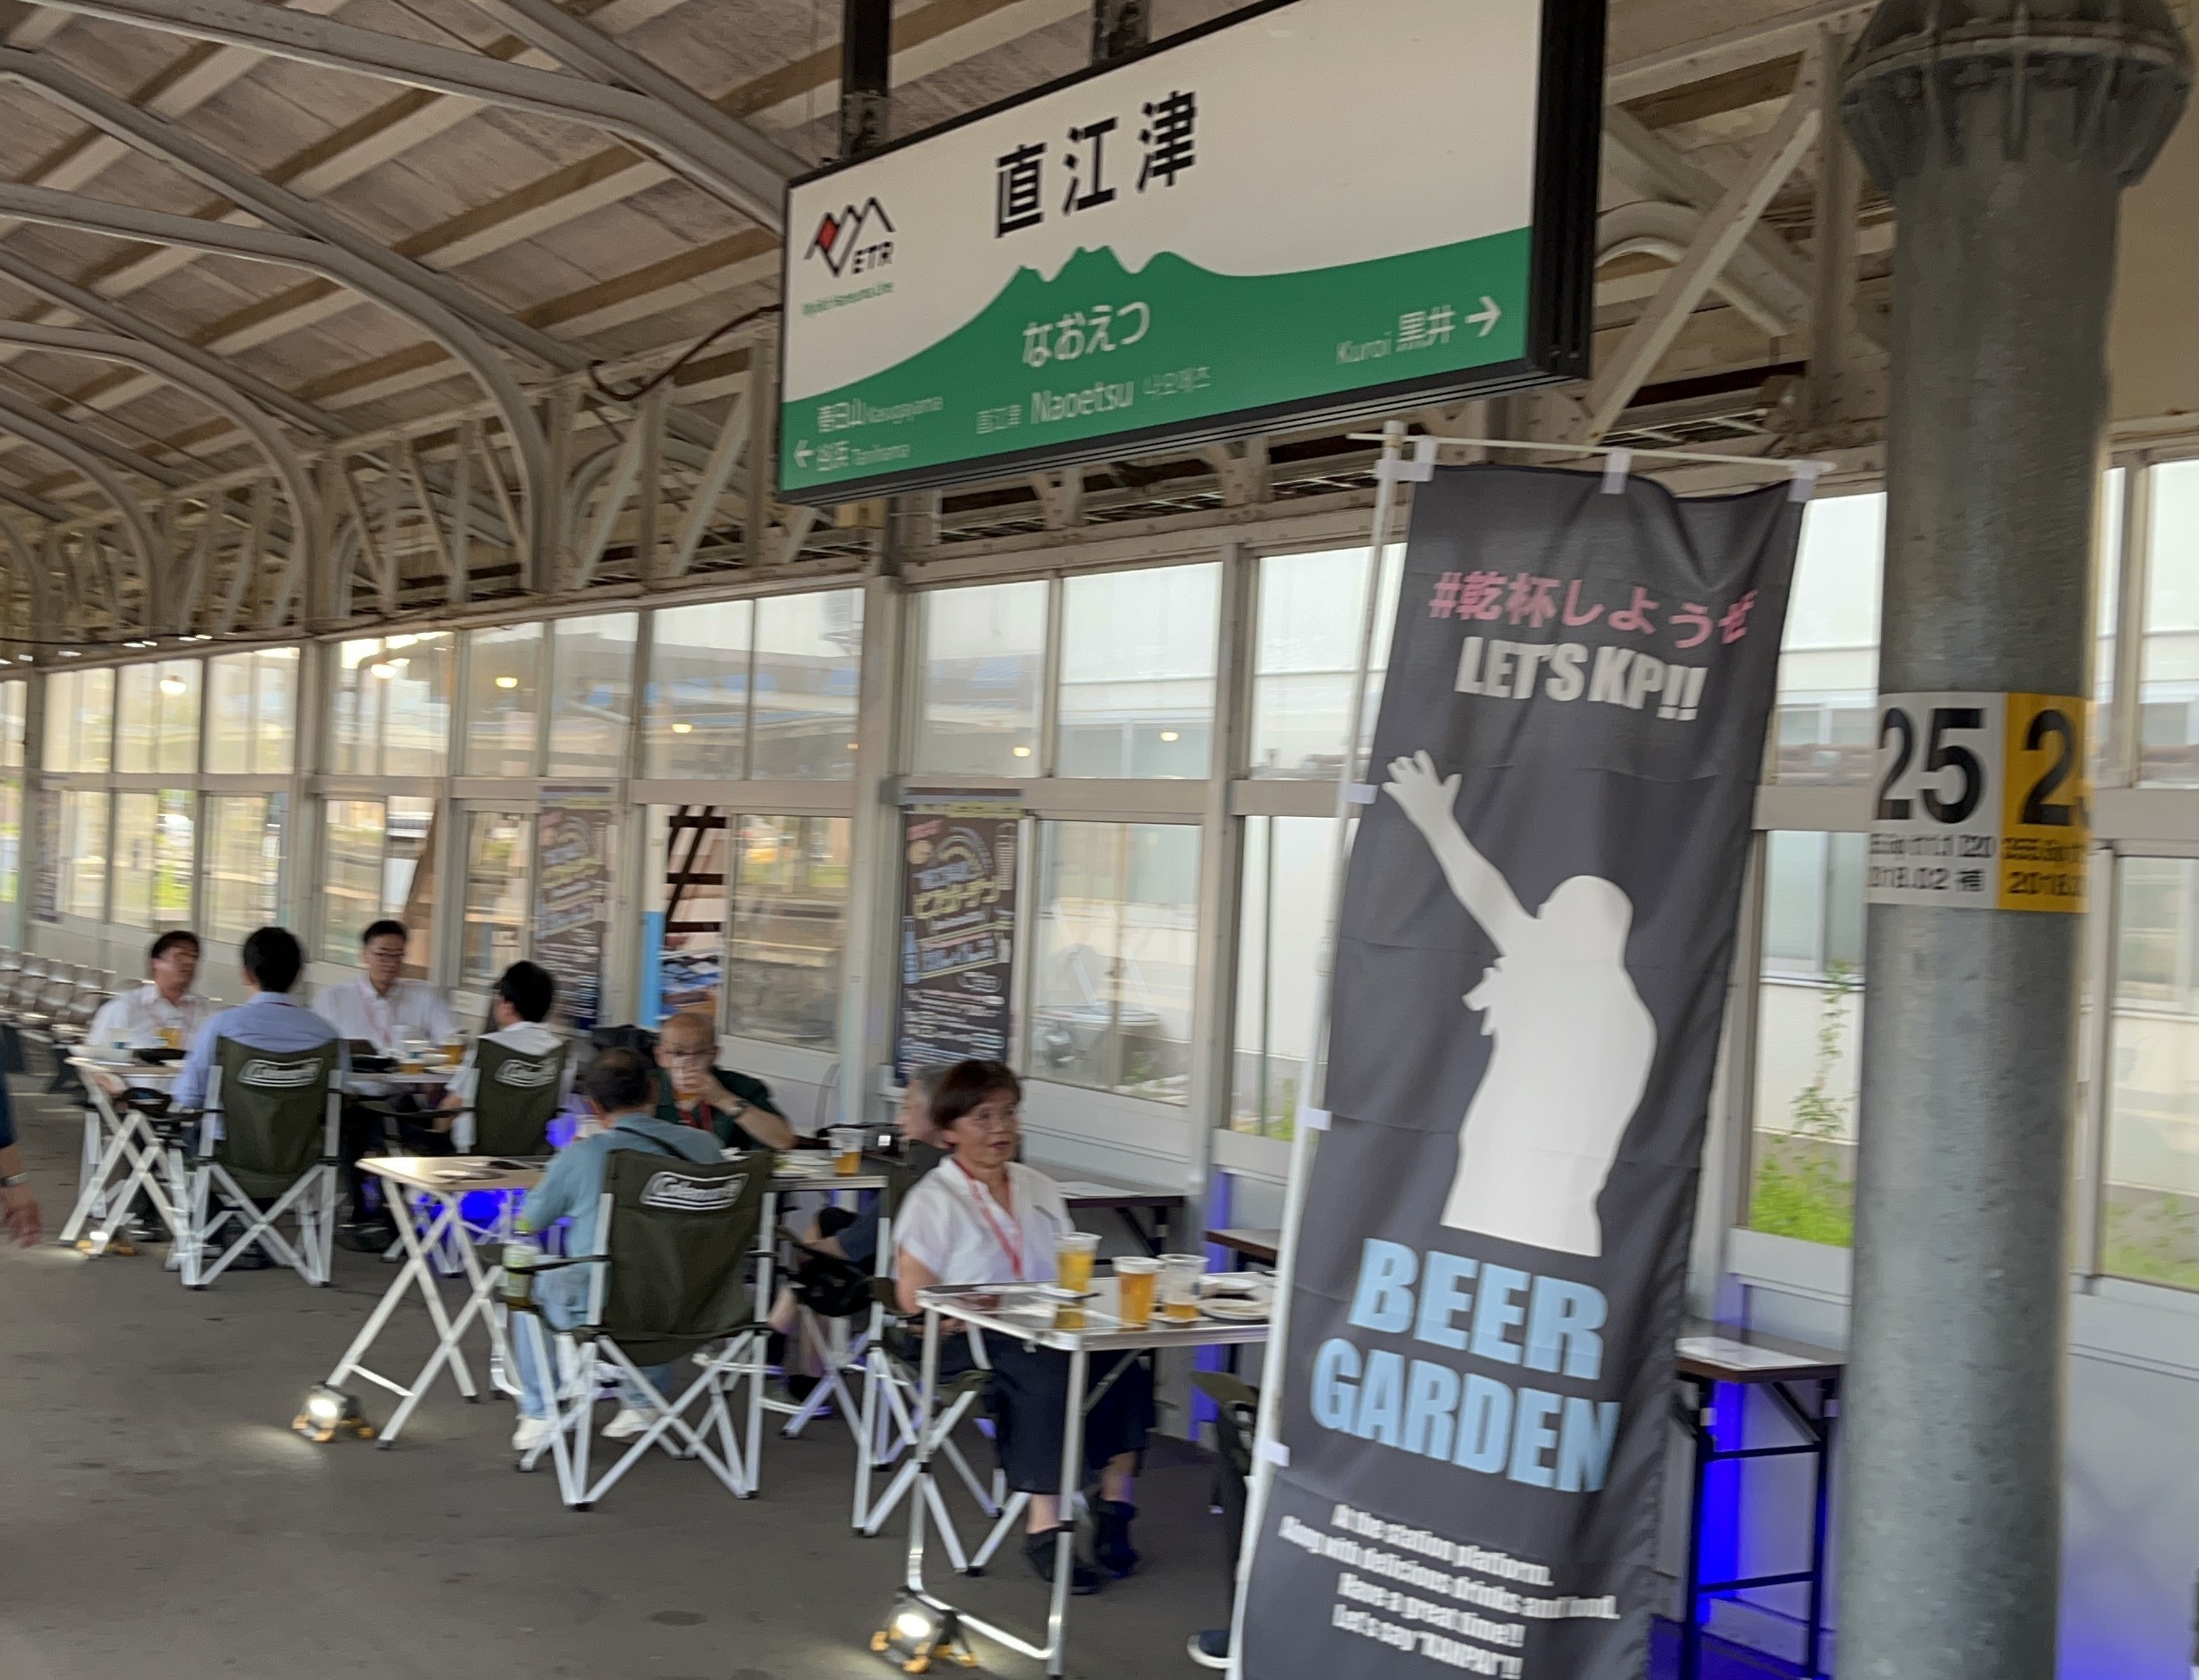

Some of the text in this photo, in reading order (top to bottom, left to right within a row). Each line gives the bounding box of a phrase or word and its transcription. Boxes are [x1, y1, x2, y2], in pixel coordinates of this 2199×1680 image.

[995, 90, 1197, 239] 直江津
[851, 241, 894, 275] ETR
[1021, 300, 1151, 367] なおえつ
[1396, 304, 1457, 352] 黒井
[1030, 382, 1134, 425] Naoetsu
[1429, 571, 1759, 648] #乾杯しようぜ
[1454, 636, 1709, 721] LET'S KP!!
[1872, 706, 1988, 825] 25
[1346, 1237, 1609, 1380] BEER
[1310, 1337, 1621, 1493] GARDEN
[1383, 1524, 1452, 1562] station
